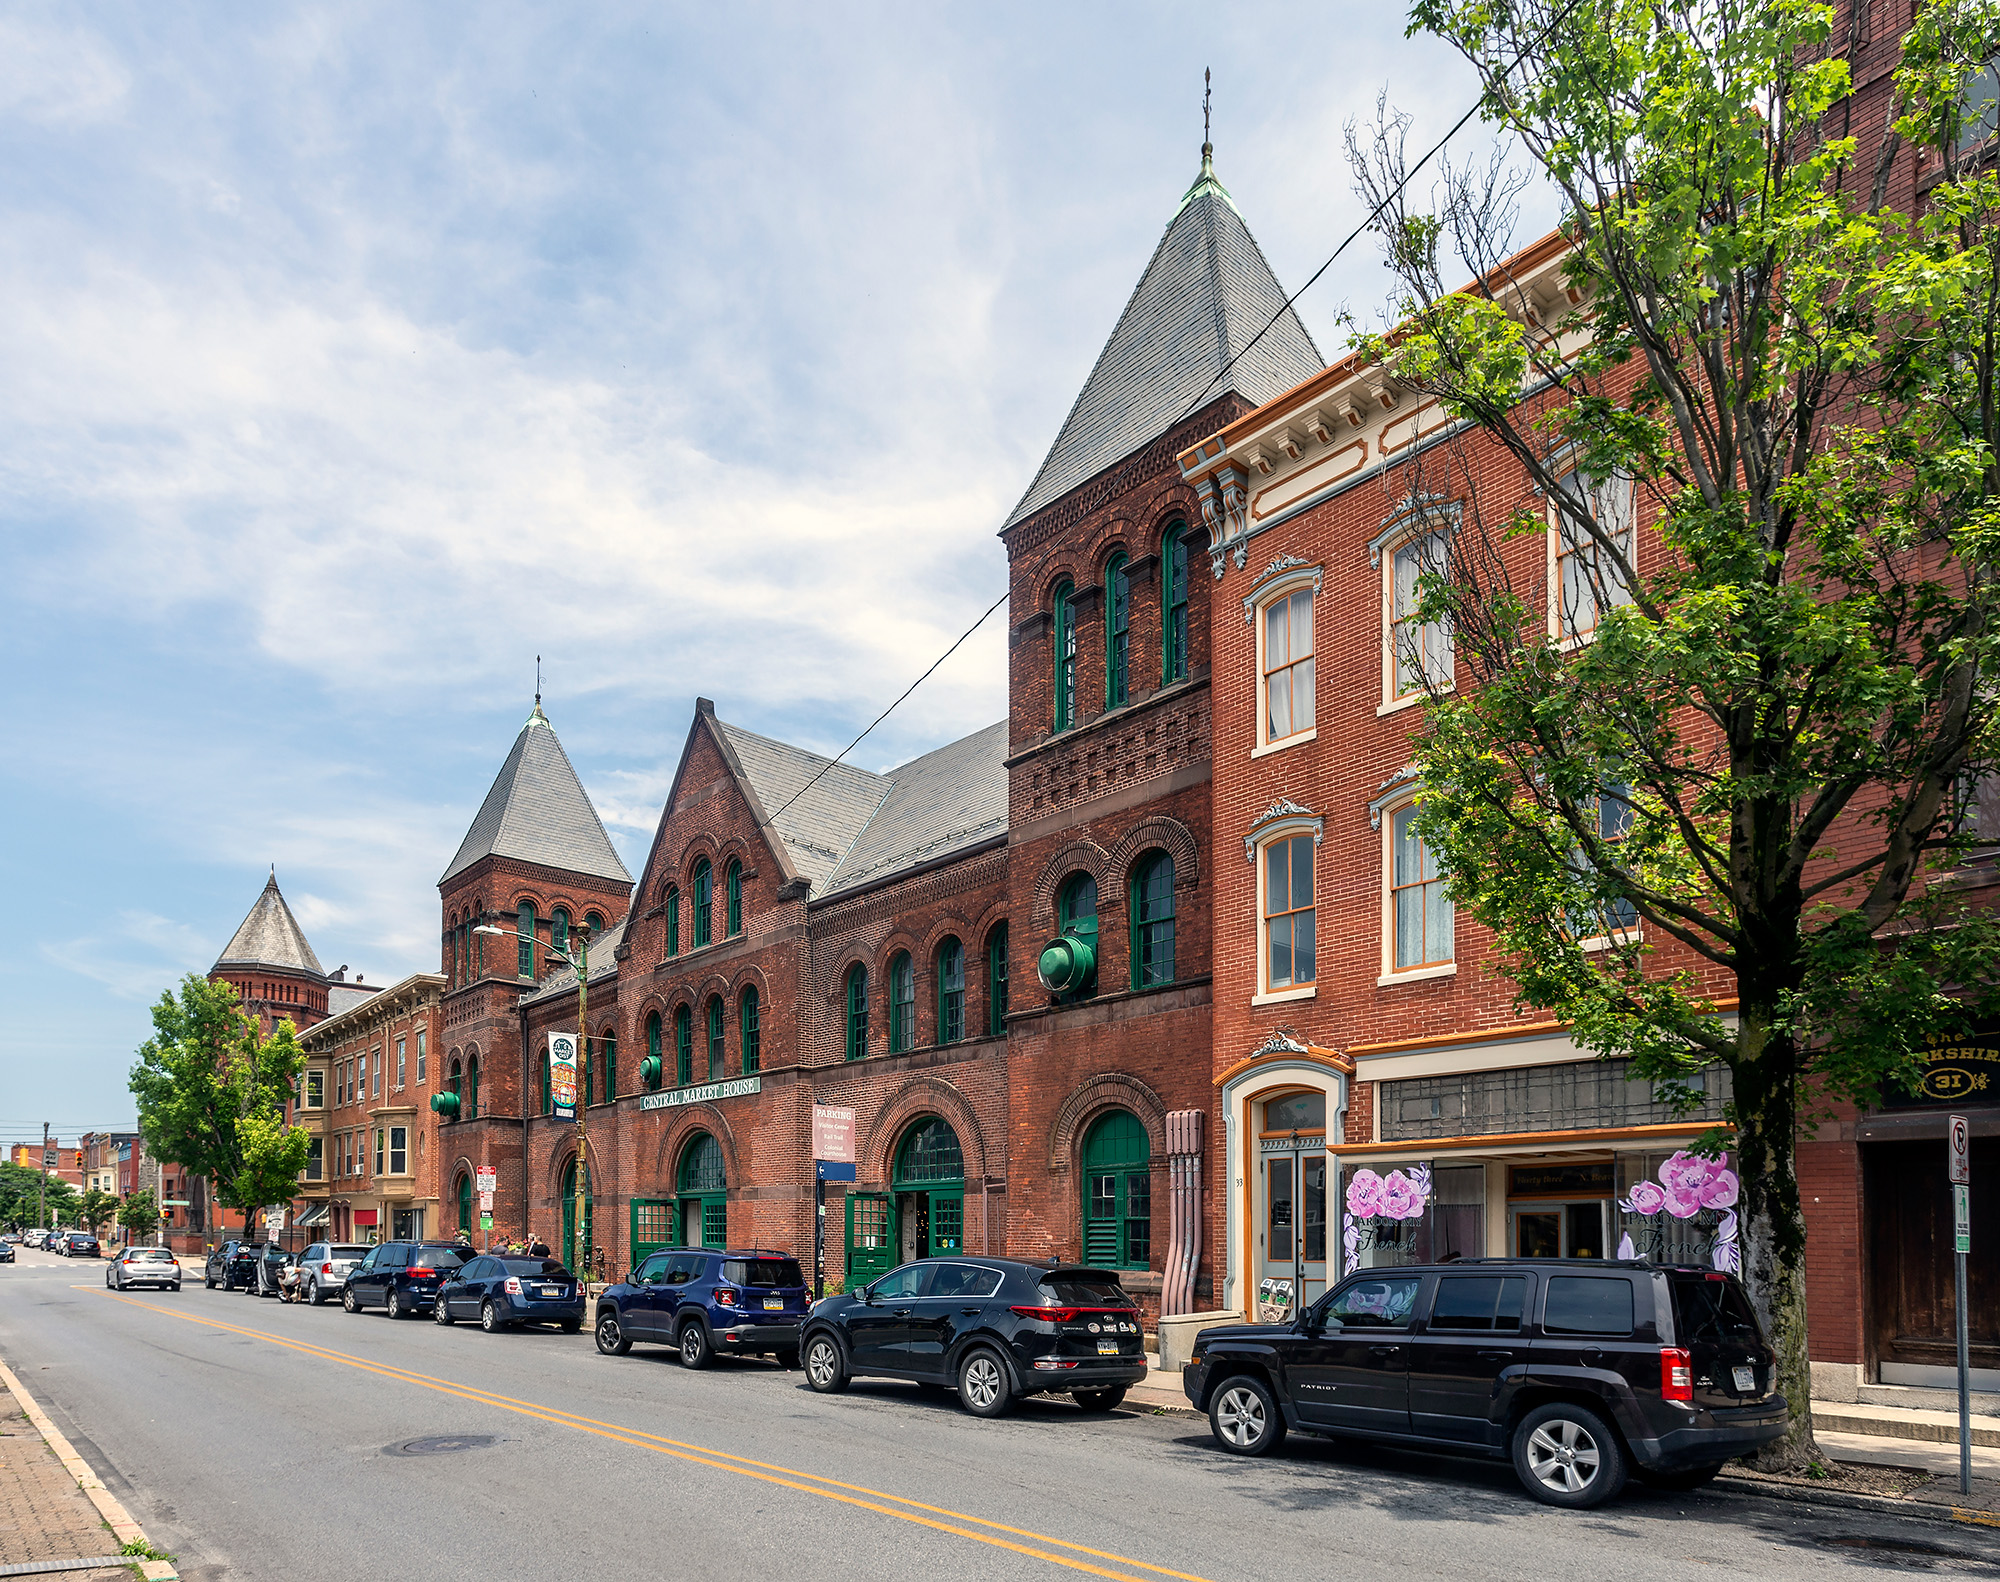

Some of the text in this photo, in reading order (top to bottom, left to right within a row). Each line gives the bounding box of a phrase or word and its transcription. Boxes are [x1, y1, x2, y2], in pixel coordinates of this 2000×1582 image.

[1935, 1075, 1961, 1089] 31
[643, 1079, 755, 1110] CENTRAL MARKET HOUSE
[816, 1109, 852, 1120] PARKING
[1235, 1178, 1243, 1187] 33
[1354, 1216, 1424, 1227] PARDON MY
[1357, 1229, 1417, 1252] French
